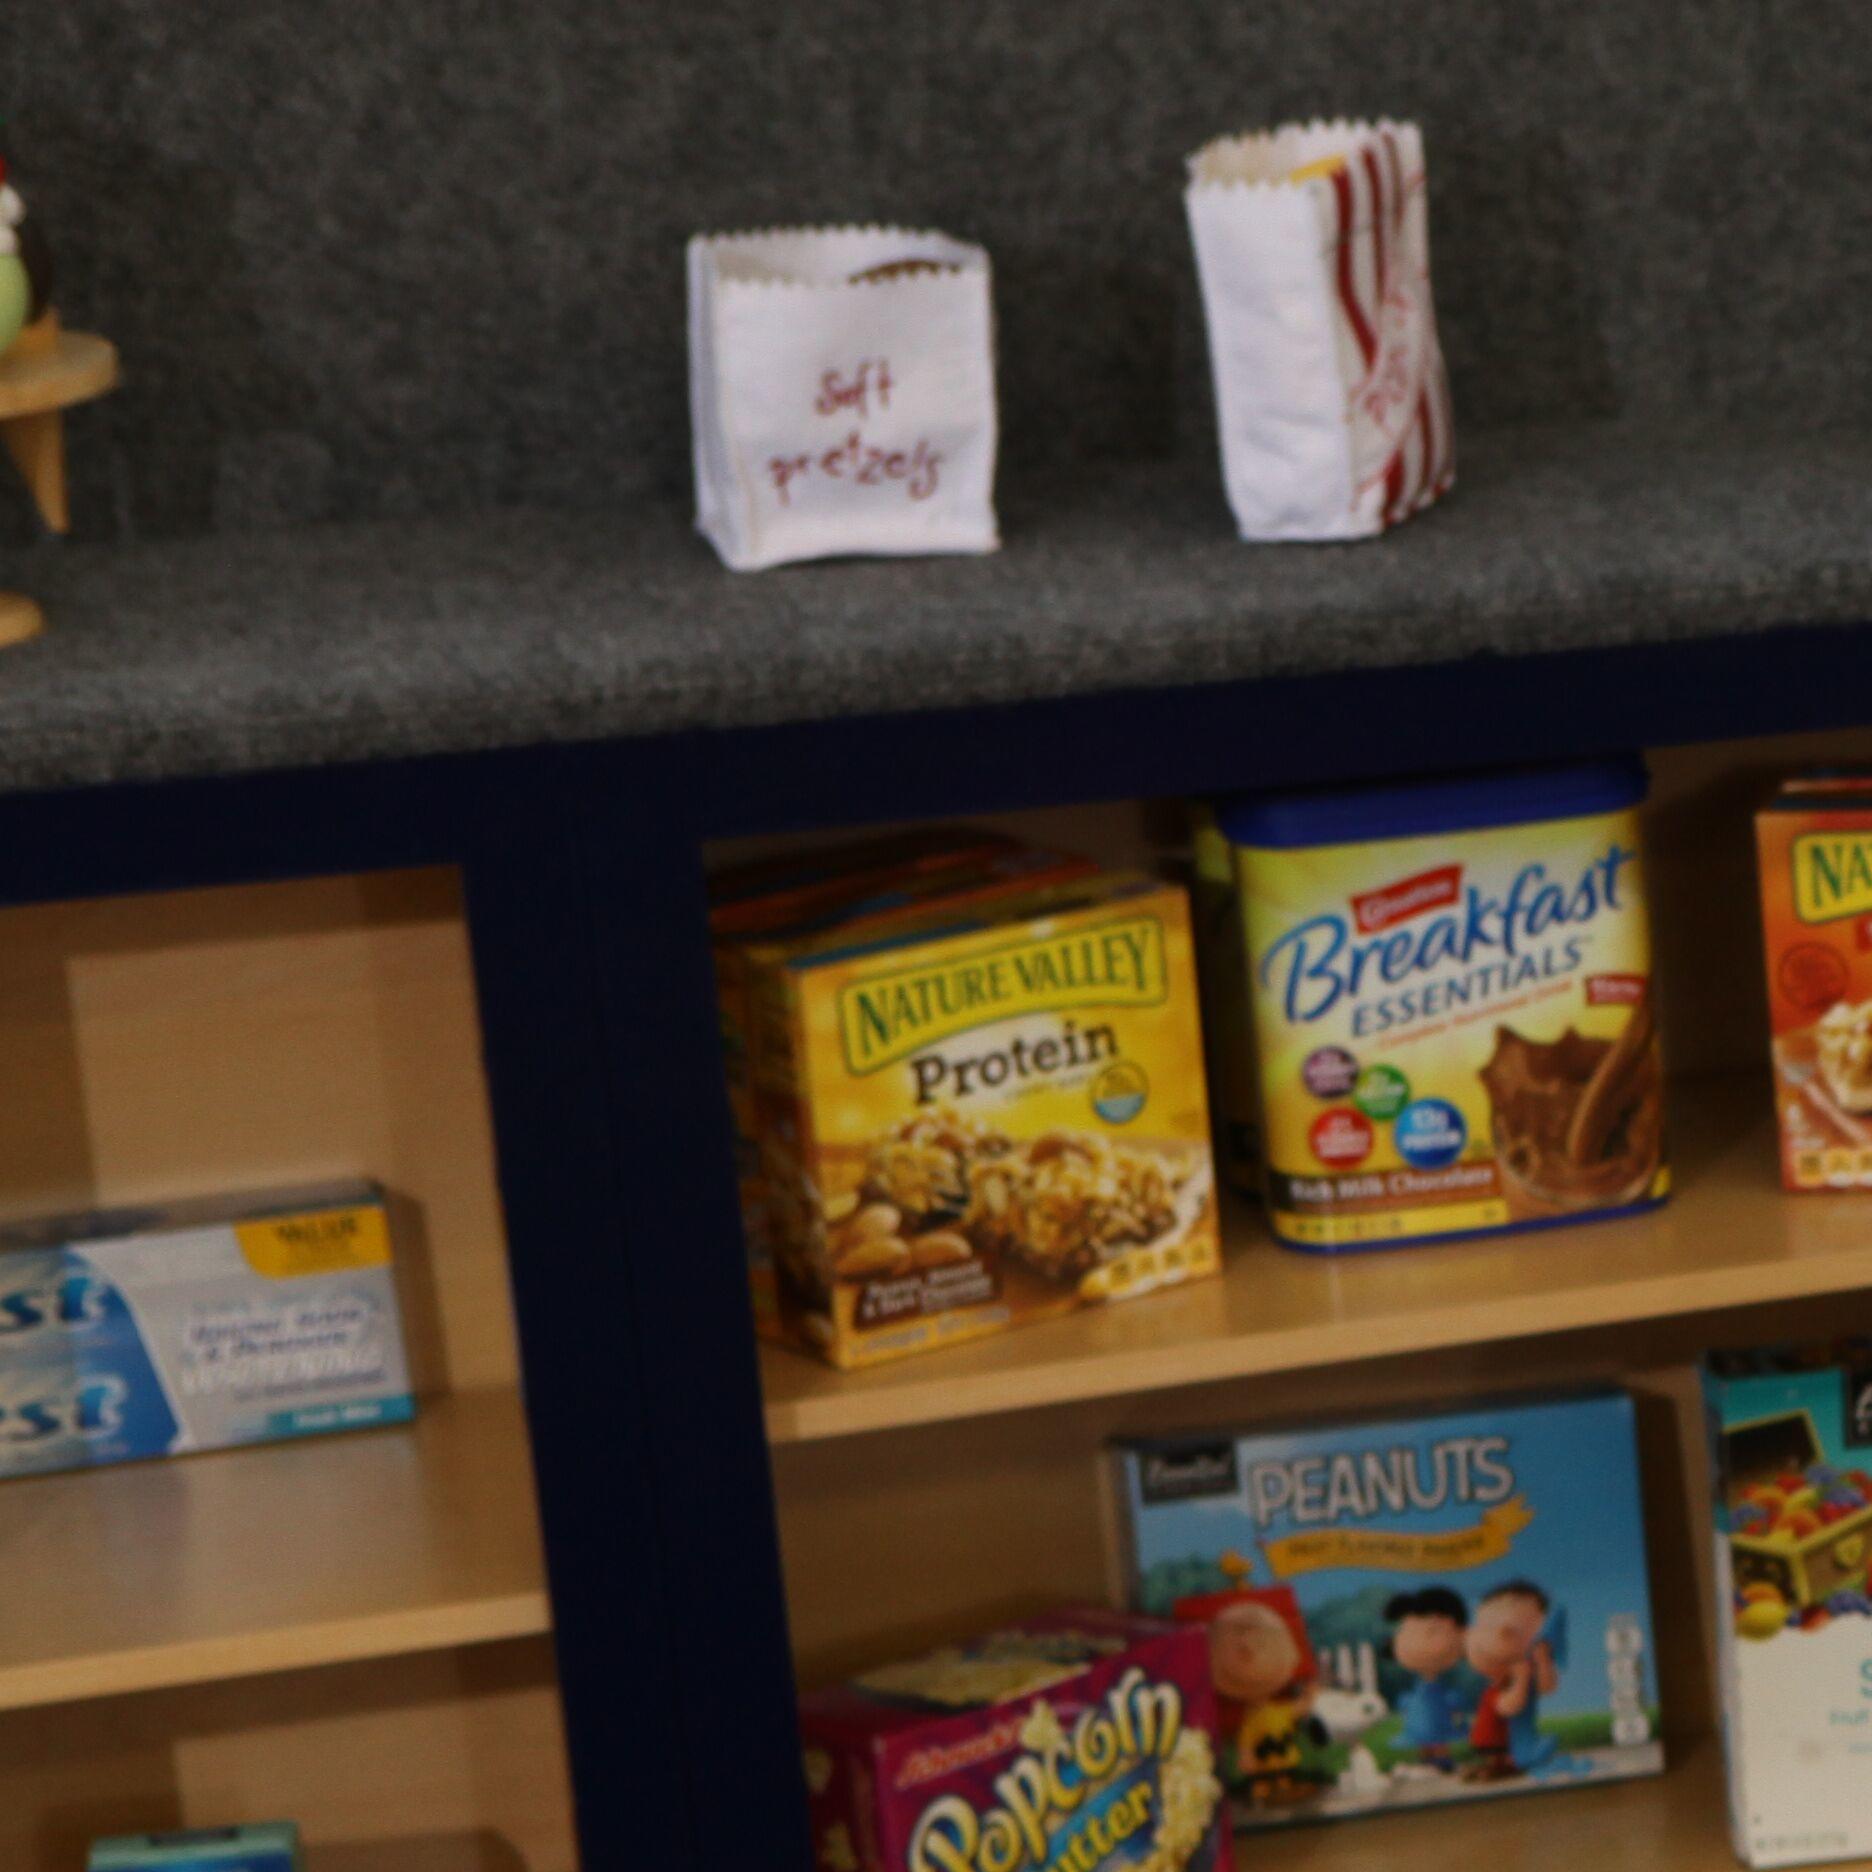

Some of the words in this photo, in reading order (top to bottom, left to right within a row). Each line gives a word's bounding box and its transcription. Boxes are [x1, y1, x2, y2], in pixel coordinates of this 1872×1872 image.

[1259, 845, 1637, 1025] Breakfast
[857, 958, 1014, 1060] NATURE
[1016, 926, 1155, 1000] VALLEY
[1351, 938, 1586, 1039] ESSENTIALS
[910, 1018, 1120, 1105] Protein
[1249, 1436, 1516, 1527] PEANUTS
